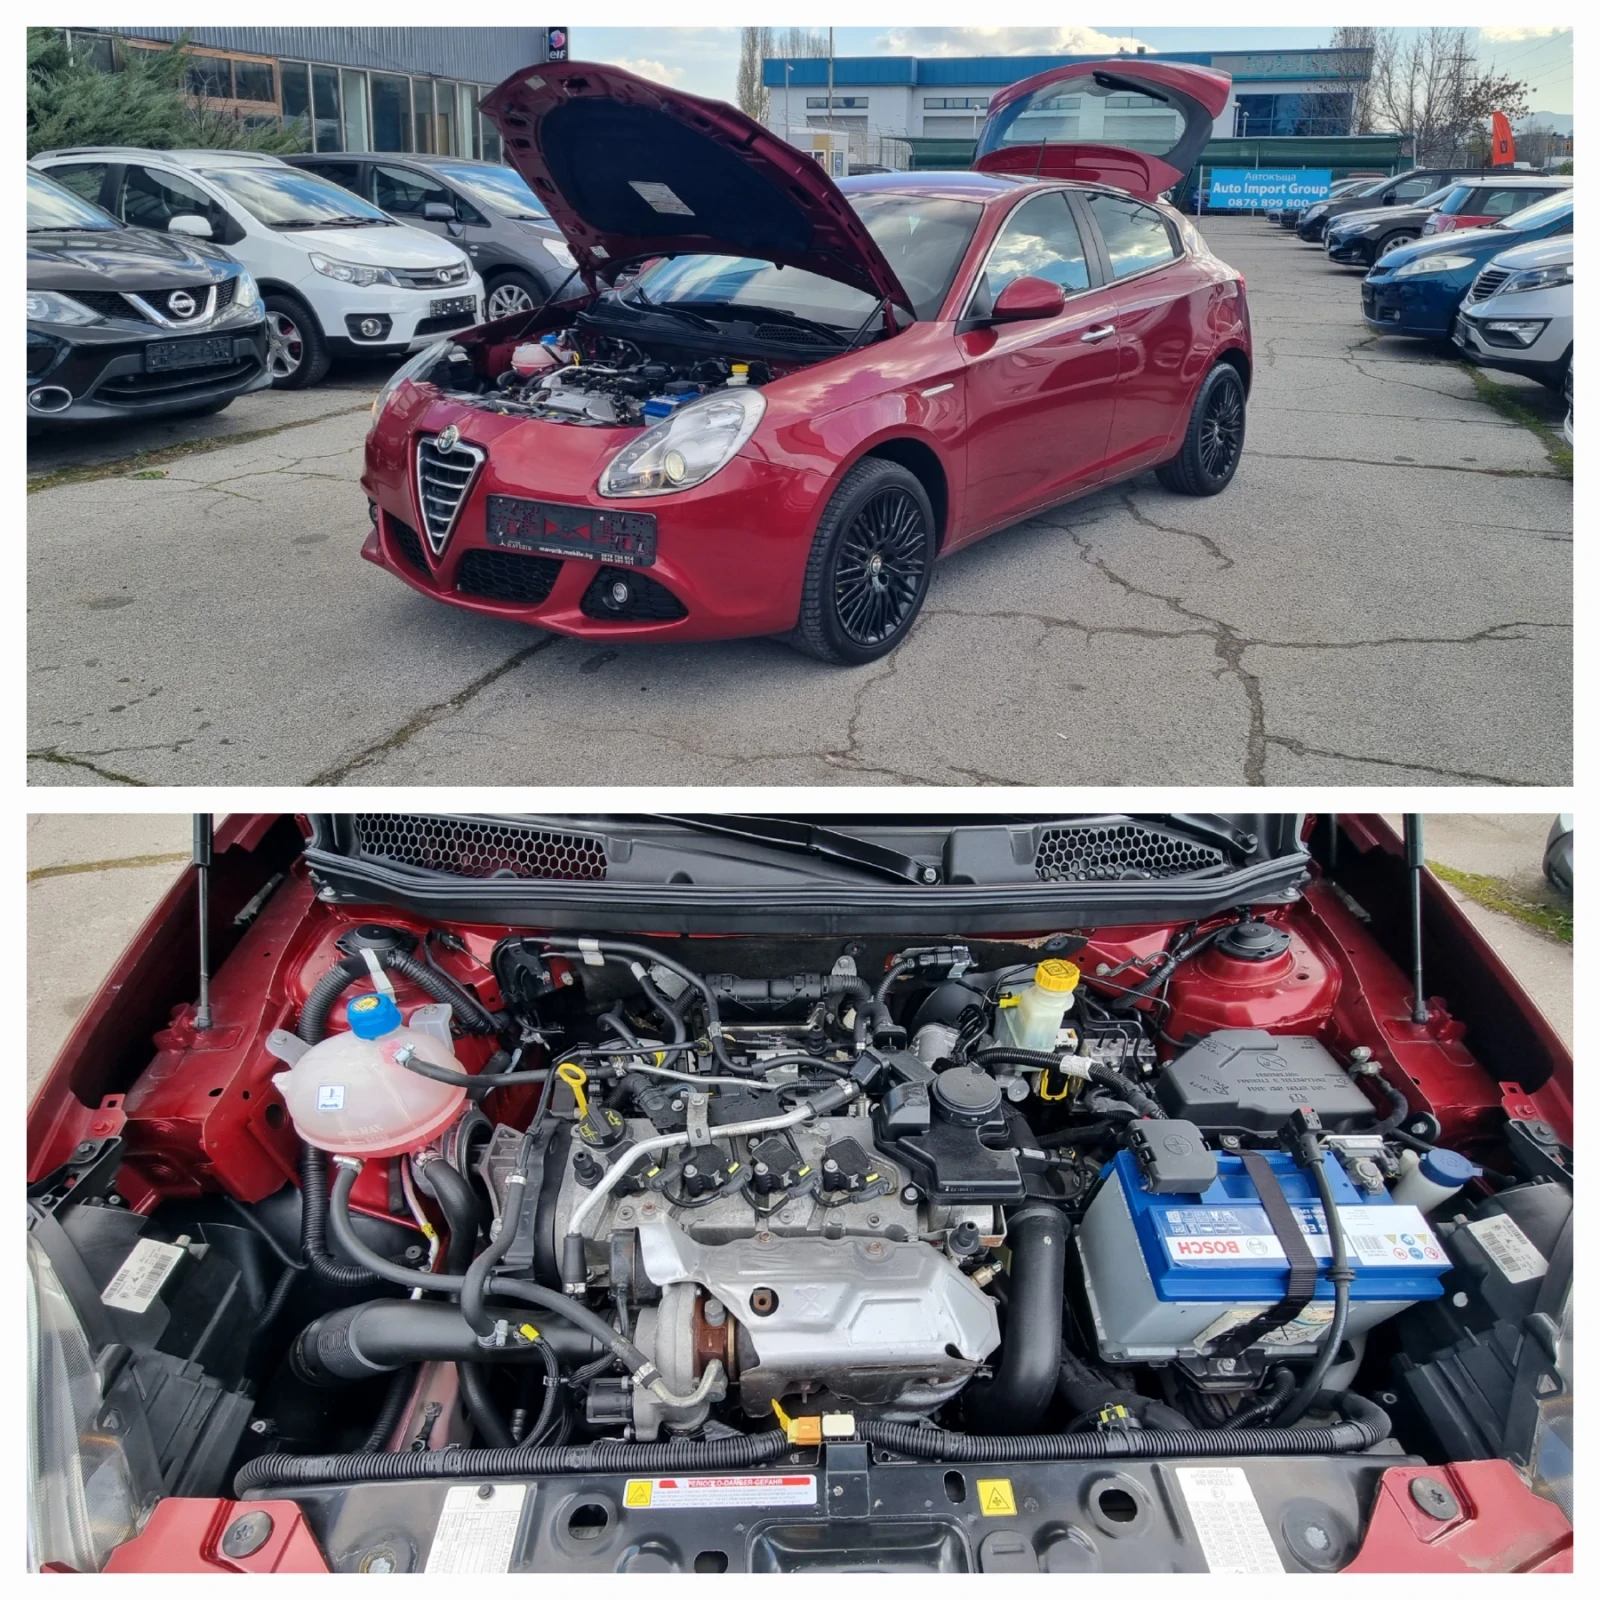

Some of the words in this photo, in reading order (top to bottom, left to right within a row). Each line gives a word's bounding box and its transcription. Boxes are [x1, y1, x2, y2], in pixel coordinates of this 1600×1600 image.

[549, 50, 567, 59] elf
[1244, 172, 1297, 182] Автокъща
[1213, 182, 1242, 194] Auto
[1244, 183, 1286, 197] Import
[1288, 183, 1329, 197] Group
[1228, 198, 1258, 207] 0876
[1260, 199, 1283, 207] 899
[1286, 199, 1309, 207] 800
[1177, 1240, 1241, 1255] BOSCH
